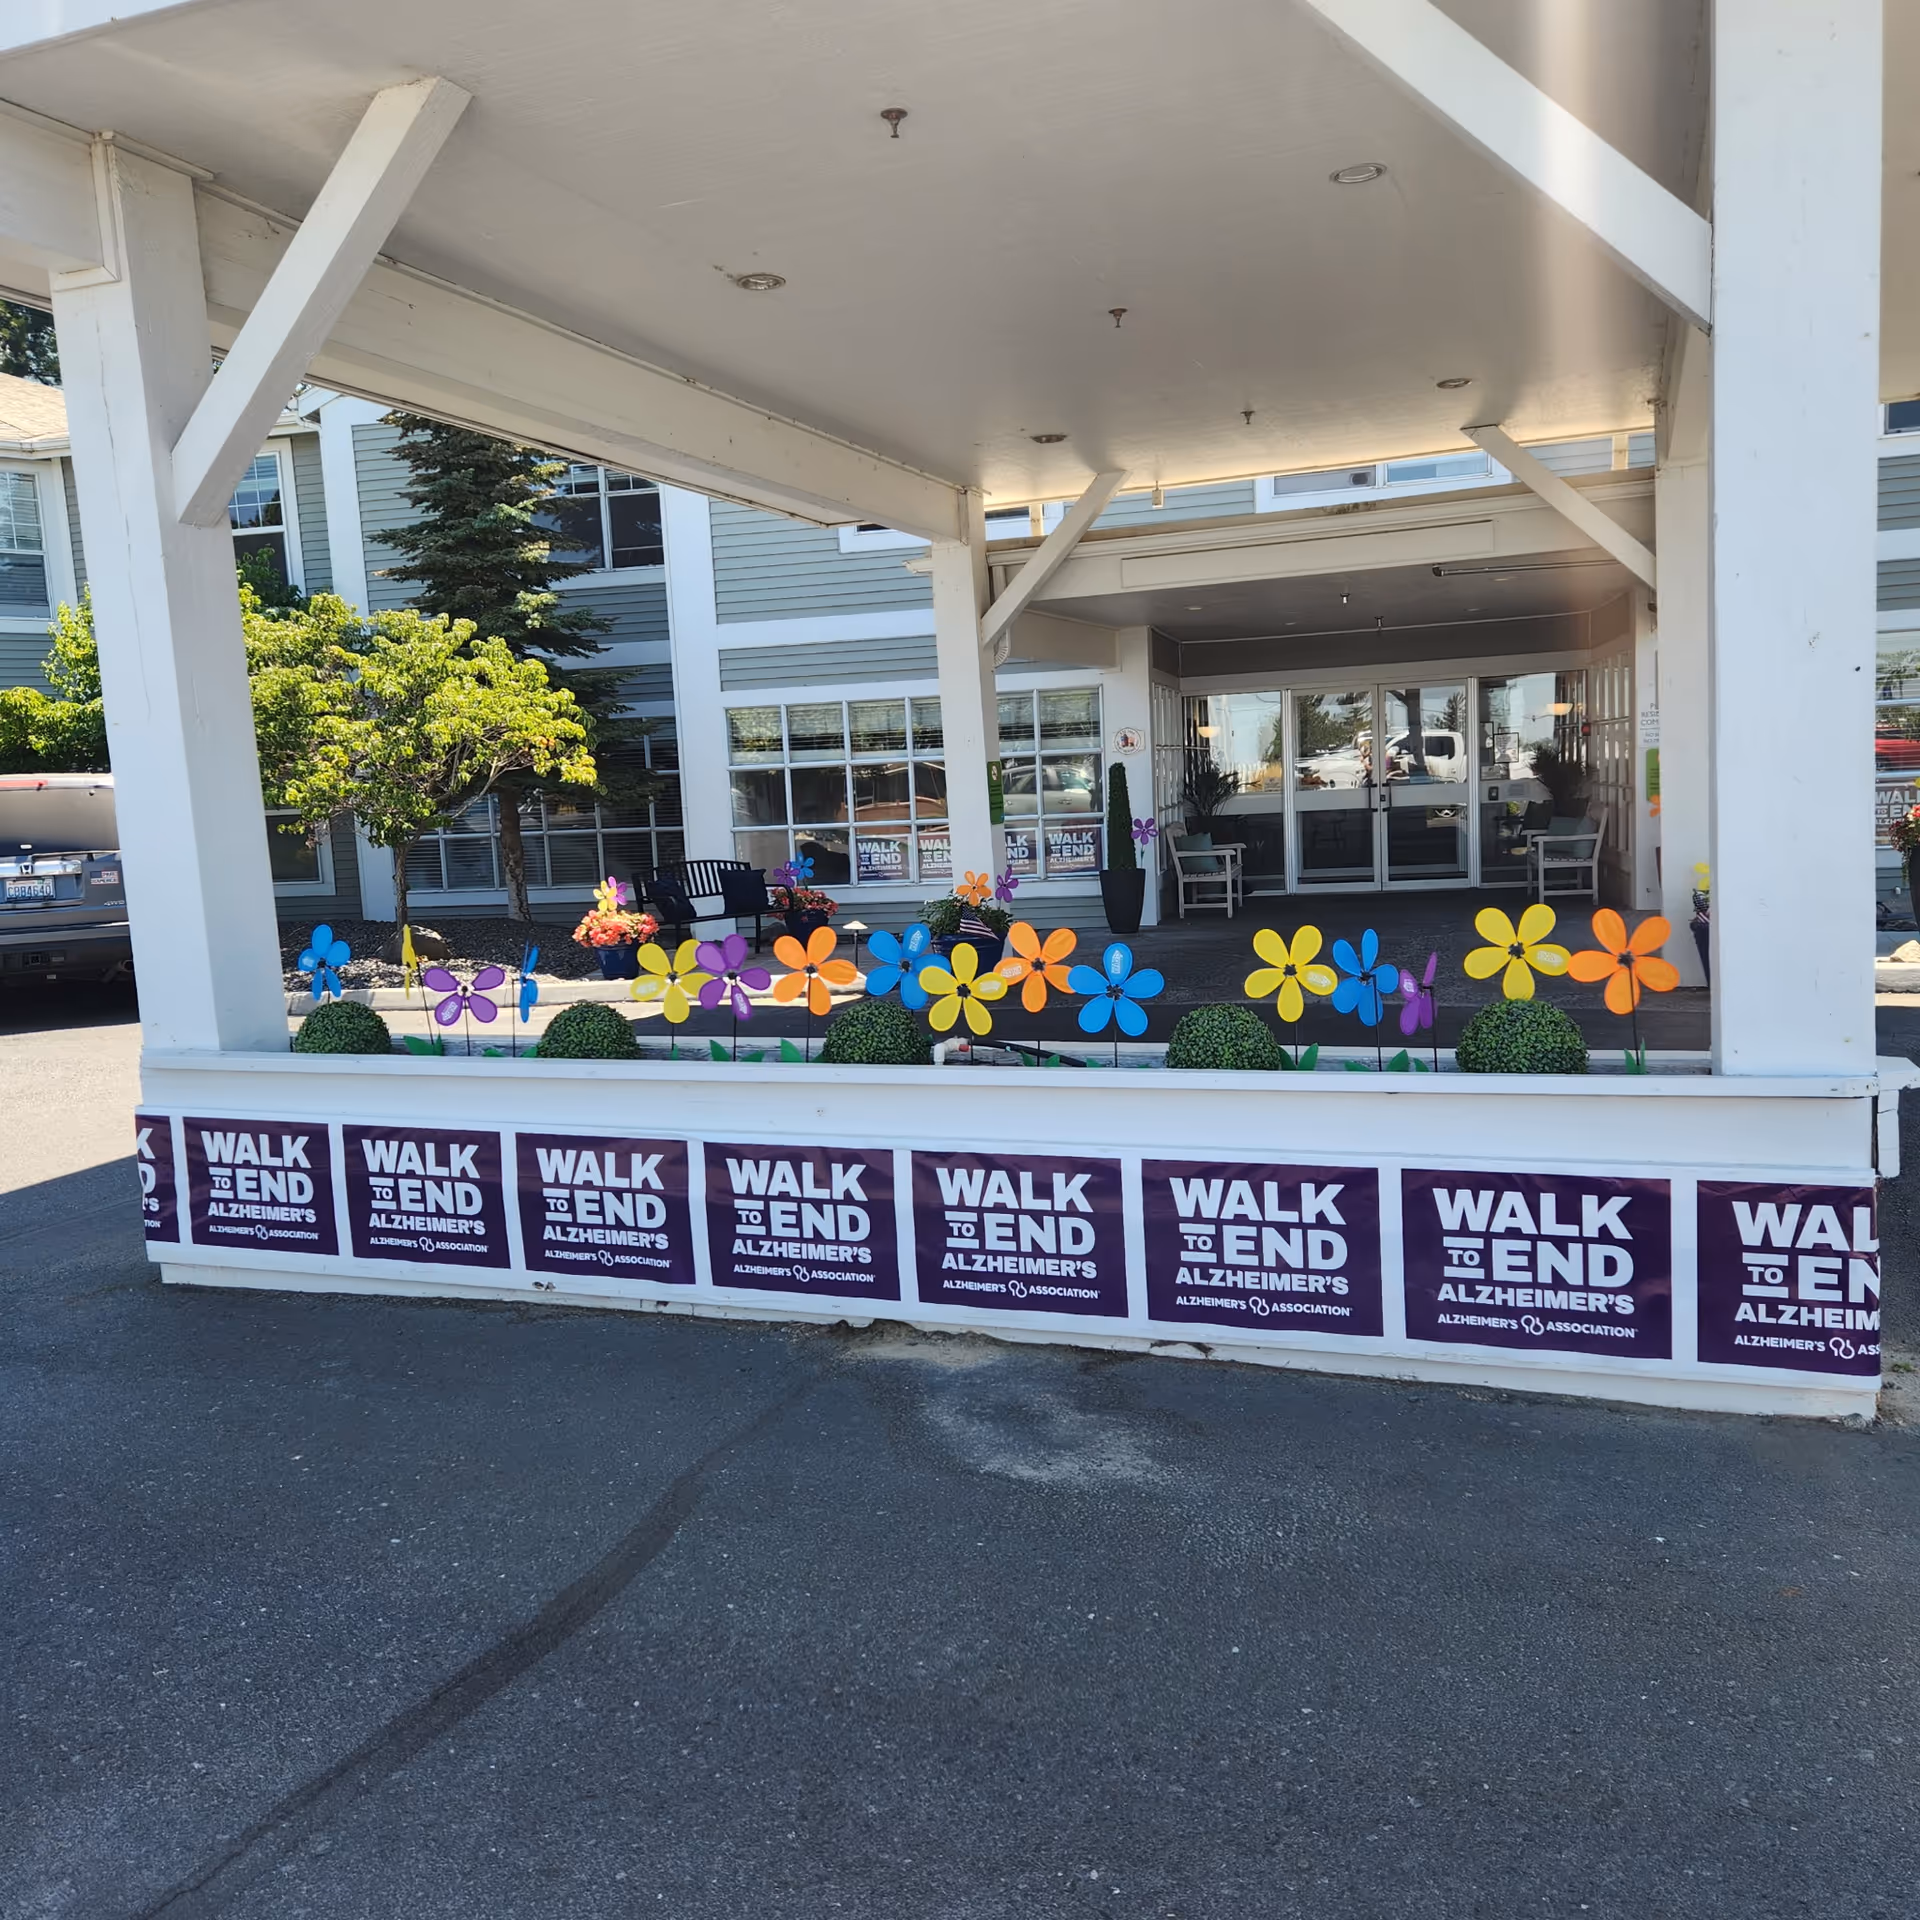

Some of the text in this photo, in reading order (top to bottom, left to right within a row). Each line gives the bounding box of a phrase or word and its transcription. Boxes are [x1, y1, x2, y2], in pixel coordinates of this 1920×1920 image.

[858, 841, 901, 853] WALK
[1005, 835, 1028, 847] LK
[1048, 832, 1094, 845] WALK
[1062, 845, 1095, 857] END
[871, 853, 902, 865] END
[201, 1131, 311, 1168] WALK
[362, 1140, 480, 1178] WALK
[536, 1148, 664, 1190] WALK
[726, 1158, 868, 1201] WALK
[213, 1169, 313, 1204] TO END
[373, 1179, 482, 1215] TO END
[936, 1168, 1093, 1212] WALK
[208, 1202, 317, 1223] ALZHEIMER'S
[546, 1190, 666, 1228] TO END
[1170, 1178, 1346, 1224] WALK
[1433, 1188, 1632, 1239] WALK
[209, 1225, 318, 1240] ALZHEIMER'S ASSOCIATION
[370, 1214, 486, 1235] ALZHEIMER'S
[738, 1201, 870, 1241] TO END
[949, 1213, 1095, 1254] TO END
[1732, 1202, 1879, 1252] WAL
[370, 1238, 487, 1253] ALZHEIMER'S ASSOCIATION
[544, 1226, 668, 1250] ALZHEIMER'S
[733, 1239, 872, 1263] ALZHEIMER'S
[1184, 1225, 1347, 1269] TO END
[545, 1250, 669, 1268] ALZHEIMER'S ASSOCIATION
[942, 1253, 1096, 1279] ALZHEIMER'S
[1448, 1239, 1633, 1287] TO END
[734, 1265, 873, 1282] ALZHEIMER'S ASSOCIATION
[1176, 1267, 1348, 1294] ALZHEIMER'S
[1748, 1255, 1881, 1303] TO EN
[944, 1280, 1098, 1298] ALZHEIMER'S ASSOCIATION
[1438, 1284, 1634, 1315] ALZHEIMER'S
[1176, 1296, 1350, 1316] ALZHEIMER'S ASSOCIATION
[1438, 1314, 1636, 1338] ALZHEIMER'S ASSOCIATION
[1735, 1335, 1825, 1351] ALZHEIMER'S
